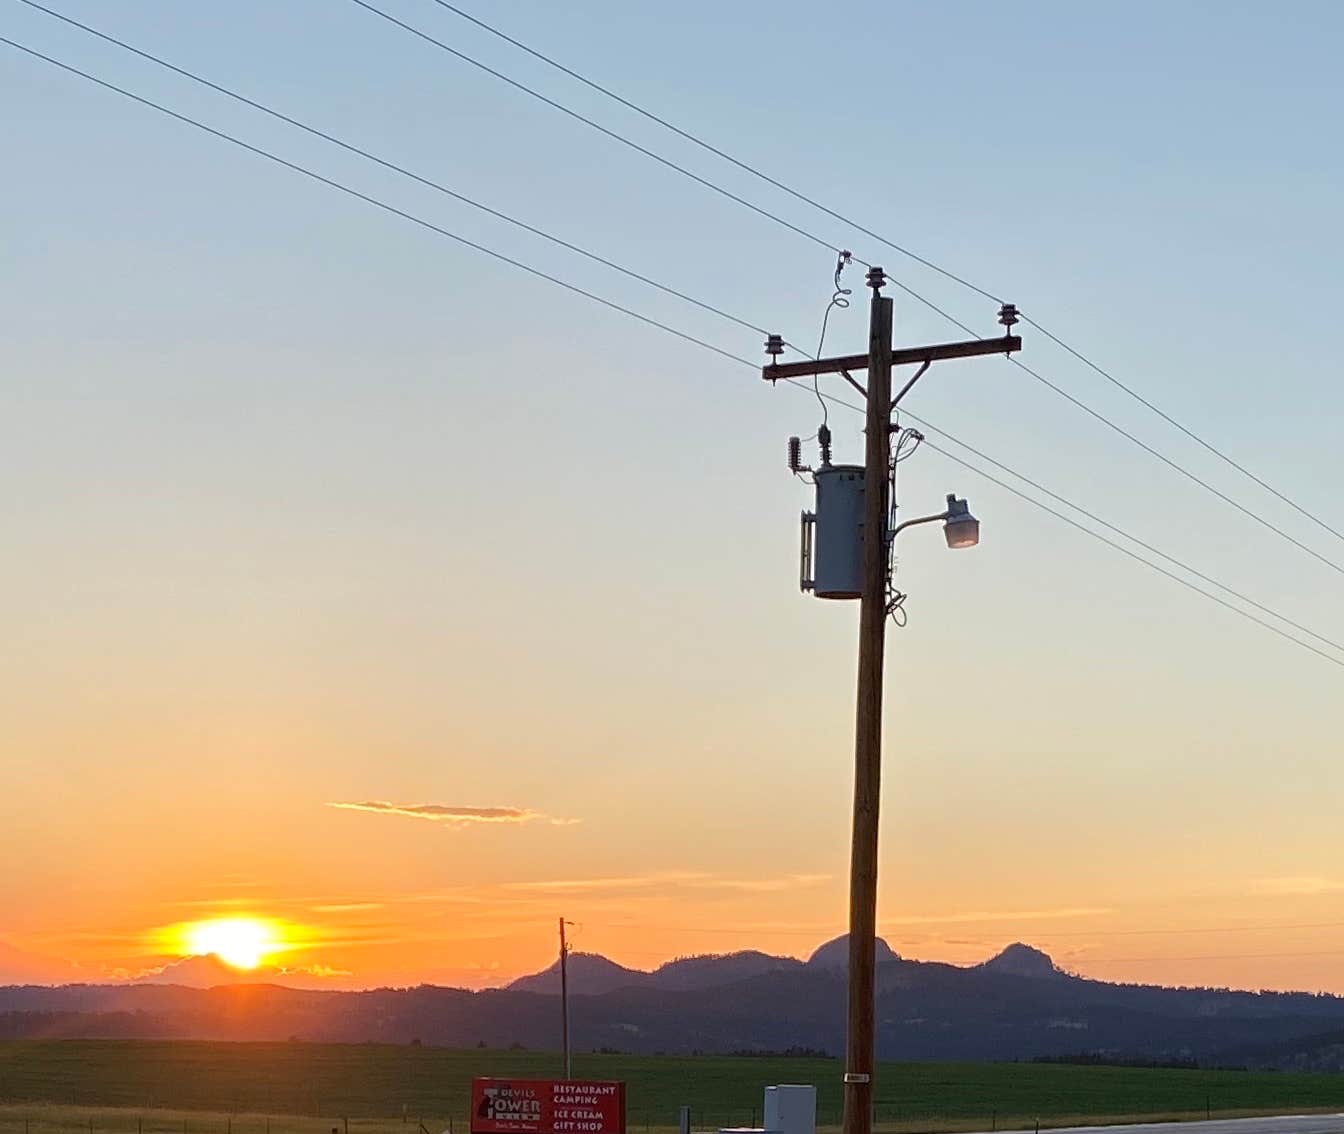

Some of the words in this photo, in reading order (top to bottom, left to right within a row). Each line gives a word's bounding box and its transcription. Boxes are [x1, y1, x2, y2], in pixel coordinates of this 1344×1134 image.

[553, 1085, 616, 1095] RESTAURANT
[553, 1095, 598, 1105] CAMPING
[554, 1110, 568, 1118] ICE
[571, 1110, 603, 1120] CREAM
[553, 1121, 575, 1131] GIFT
[577, 1121, 603, 1131] SHOP
